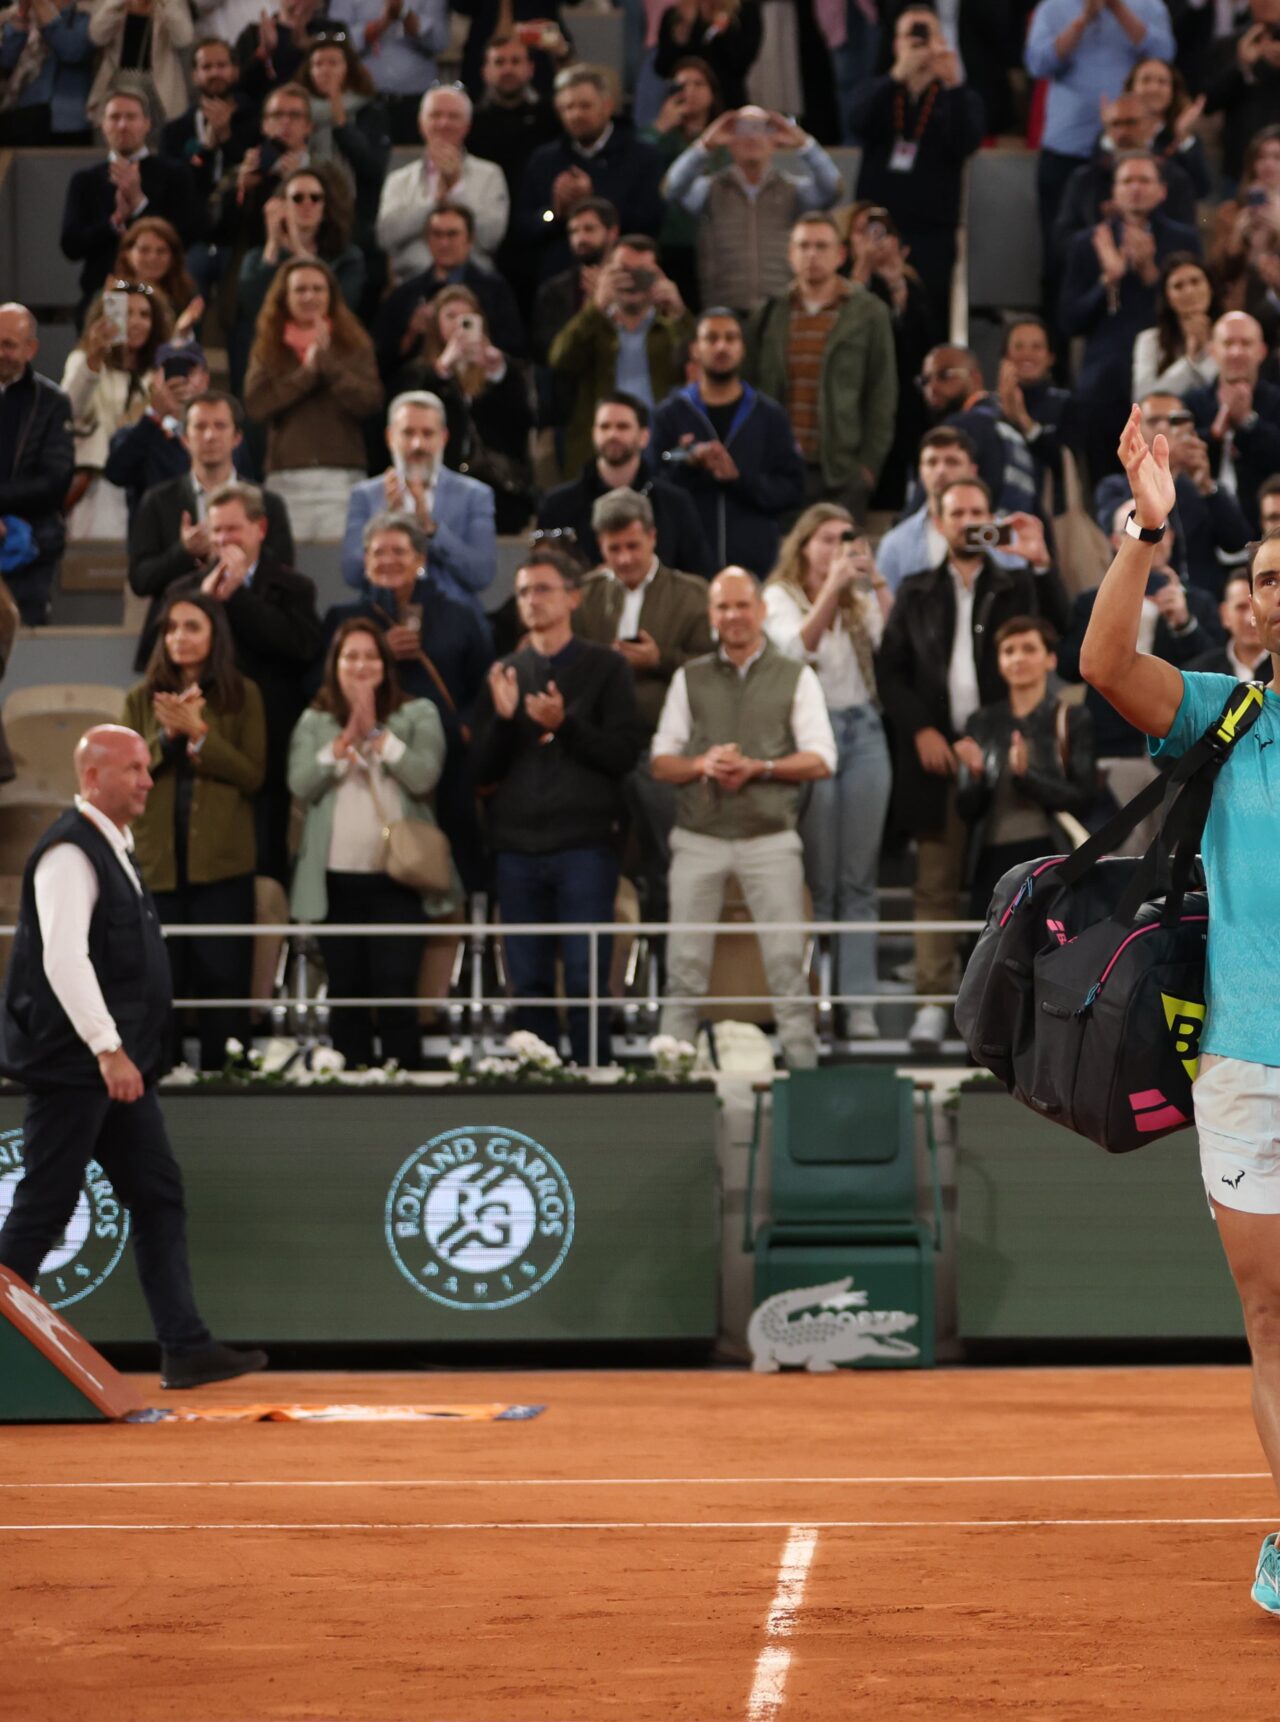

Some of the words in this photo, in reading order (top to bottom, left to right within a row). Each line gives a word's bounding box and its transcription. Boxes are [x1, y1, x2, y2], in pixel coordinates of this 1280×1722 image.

[395, 1137, 478, 1238] ROLAND
[486, 1137, 565, 1238] GARROS
[421, 1261, 537, 1298] PARIS
